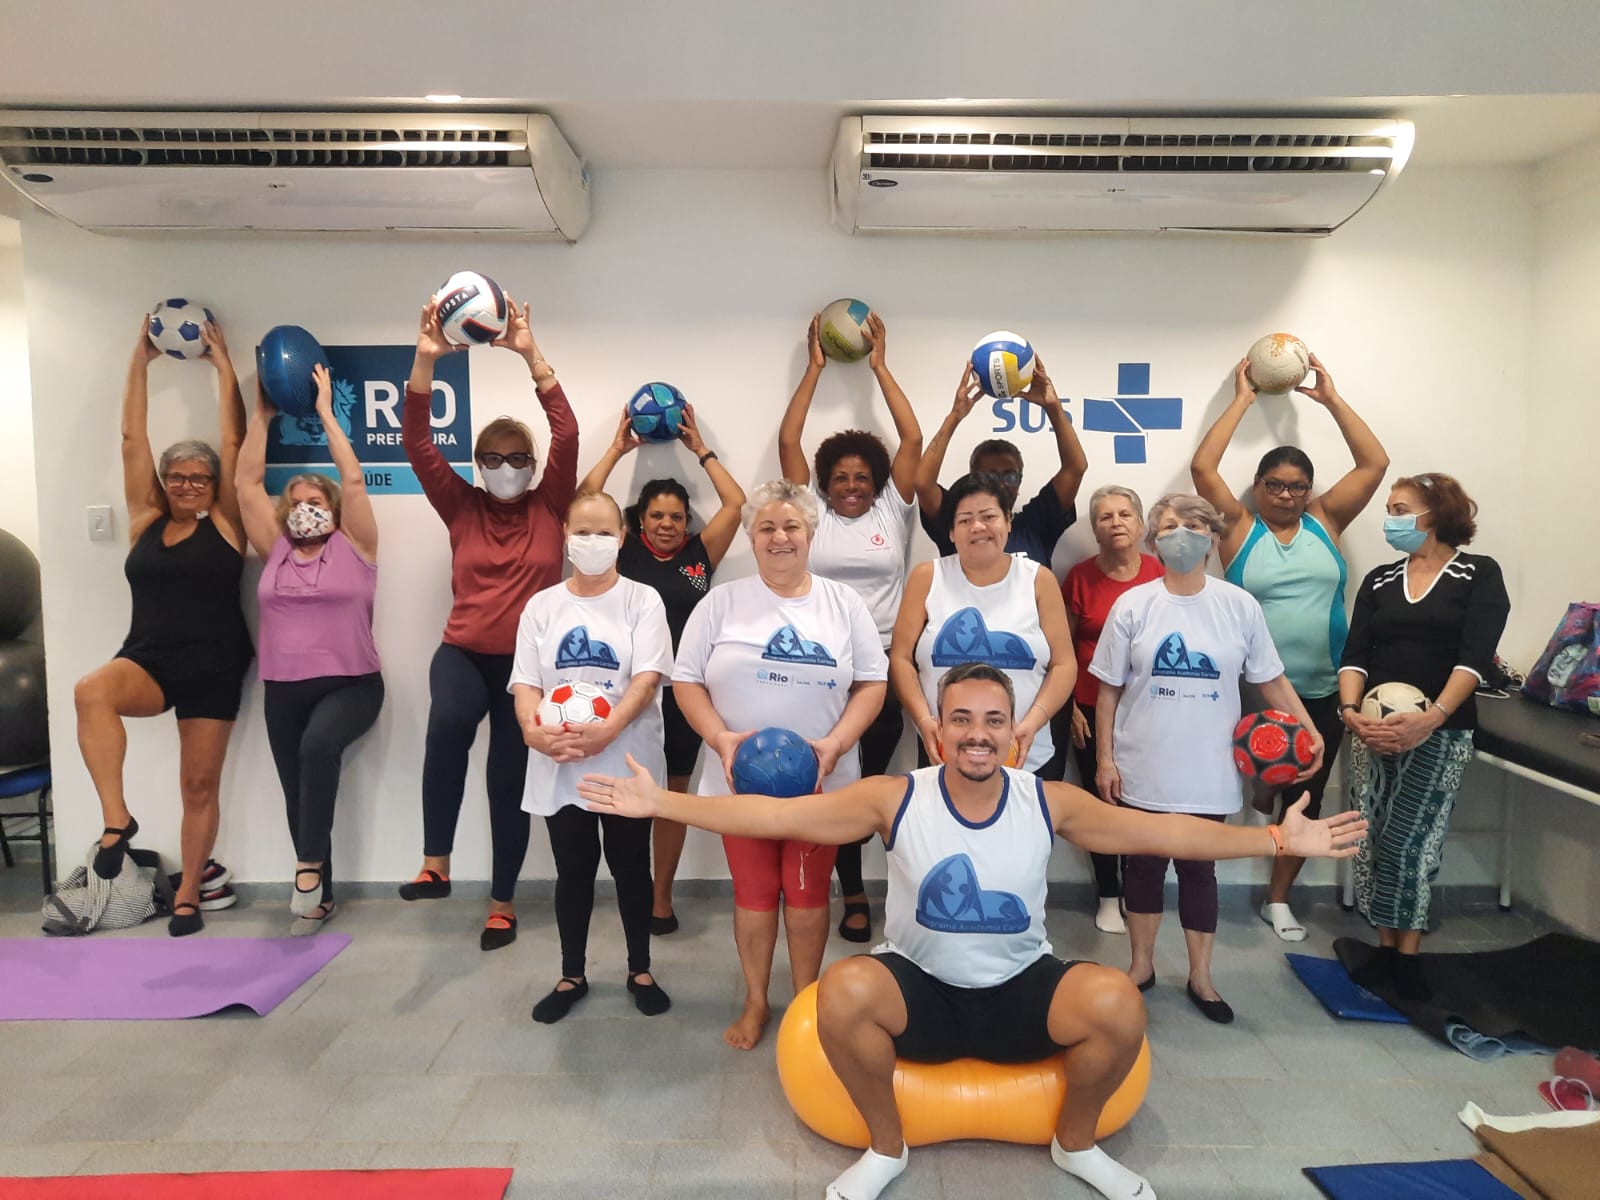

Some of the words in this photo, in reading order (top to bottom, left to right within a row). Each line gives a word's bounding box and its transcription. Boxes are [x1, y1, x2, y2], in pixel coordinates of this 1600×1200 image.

[364, 380, 456, 428] RO
[366, 432, 457, 446] PREFRA
[365, 470, 392, 486] ÚDE
[769, 672, 789, 682] Rio
[1159, 687, 1176, 696] Rio
